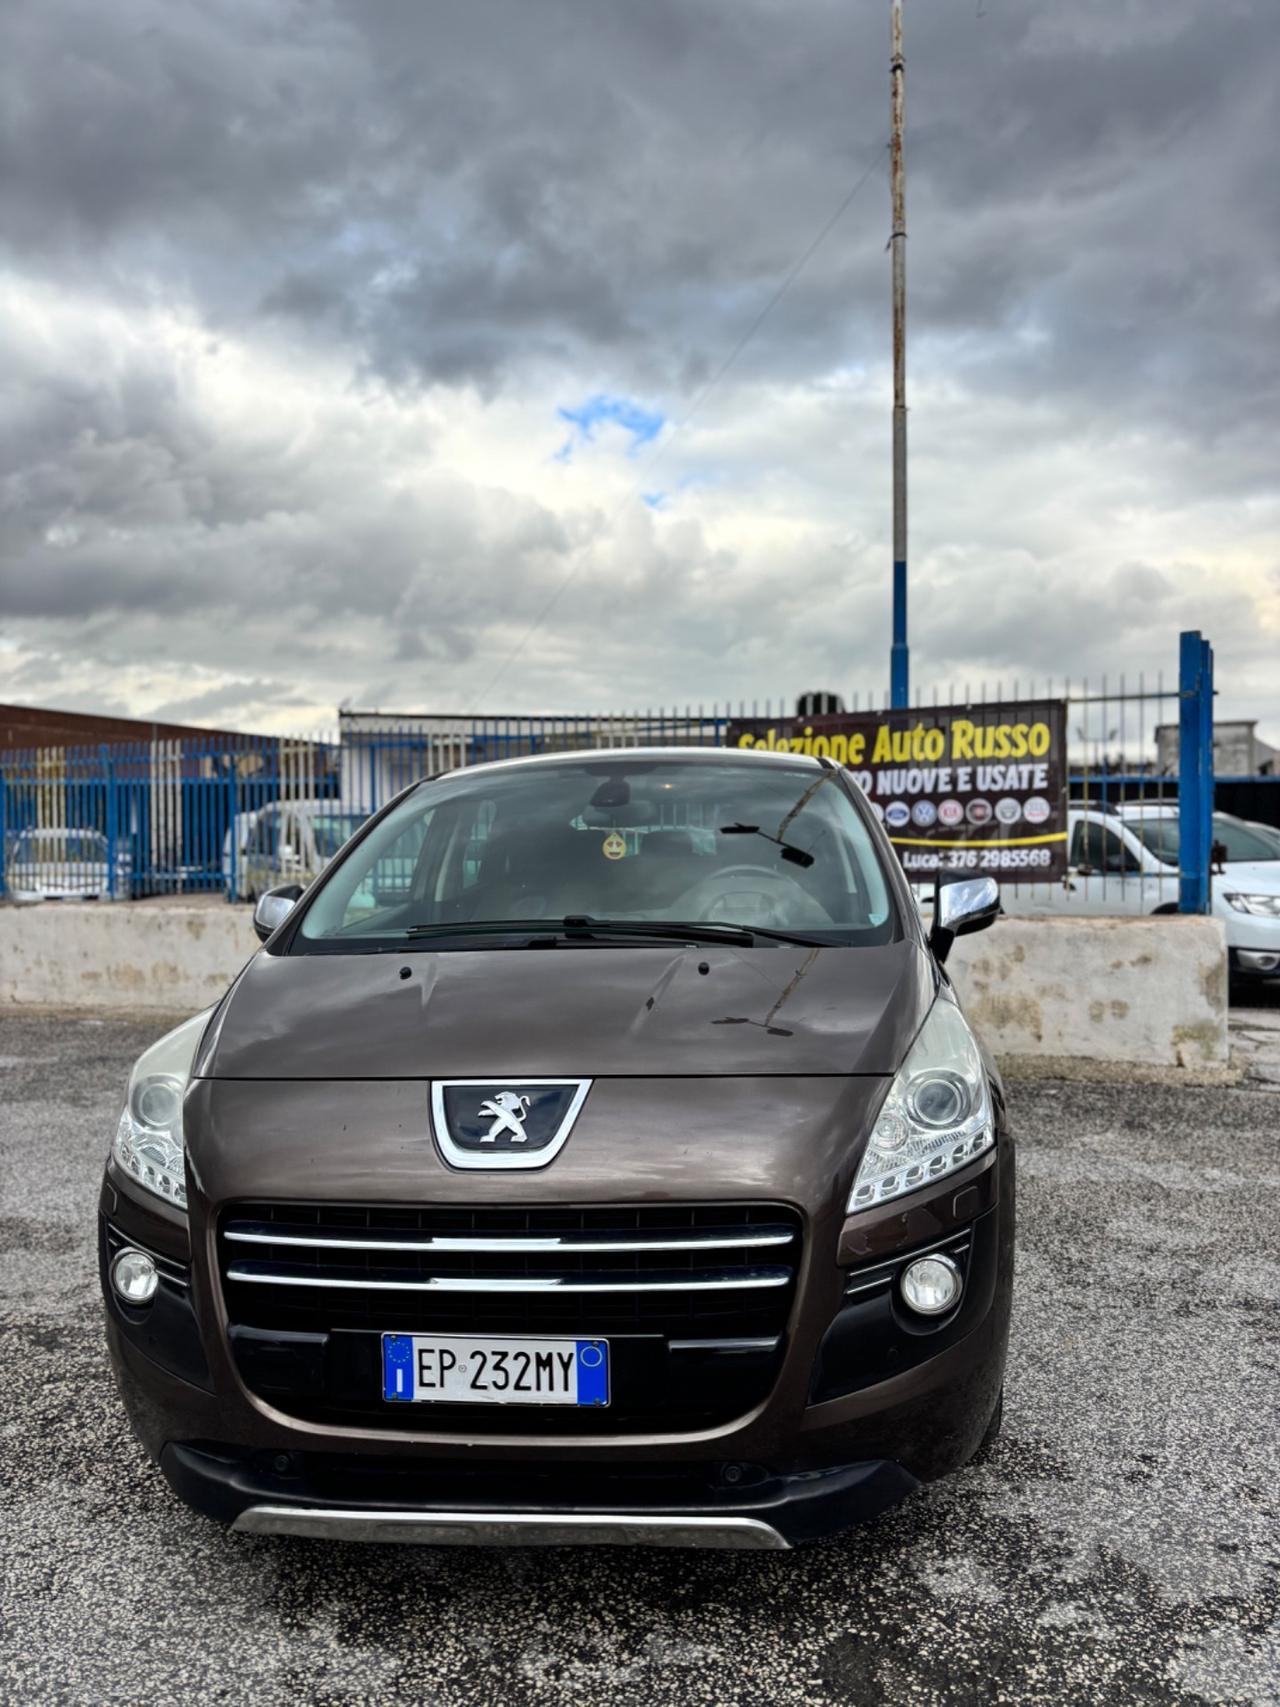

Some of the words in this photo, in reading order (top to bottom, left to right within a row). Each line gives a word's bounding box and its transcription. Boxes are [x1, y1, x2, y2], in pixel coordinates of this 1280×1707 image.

[872, 722, 945, 763] Auto
[951, 719, 1050, 760] Russo
[876, 767, 952, 795] NUOVE
[957, 765, 973, 793] E
[976, 763, 1049, 792] USATE
[902, 851, 944, 868] Luca:
[947, 850, 977, 867] 376
[979, 848, 1051, 868] 2985568
[417, 1348, 456, 1388] EP
[469, 1351, 575, 1392] 232MY
